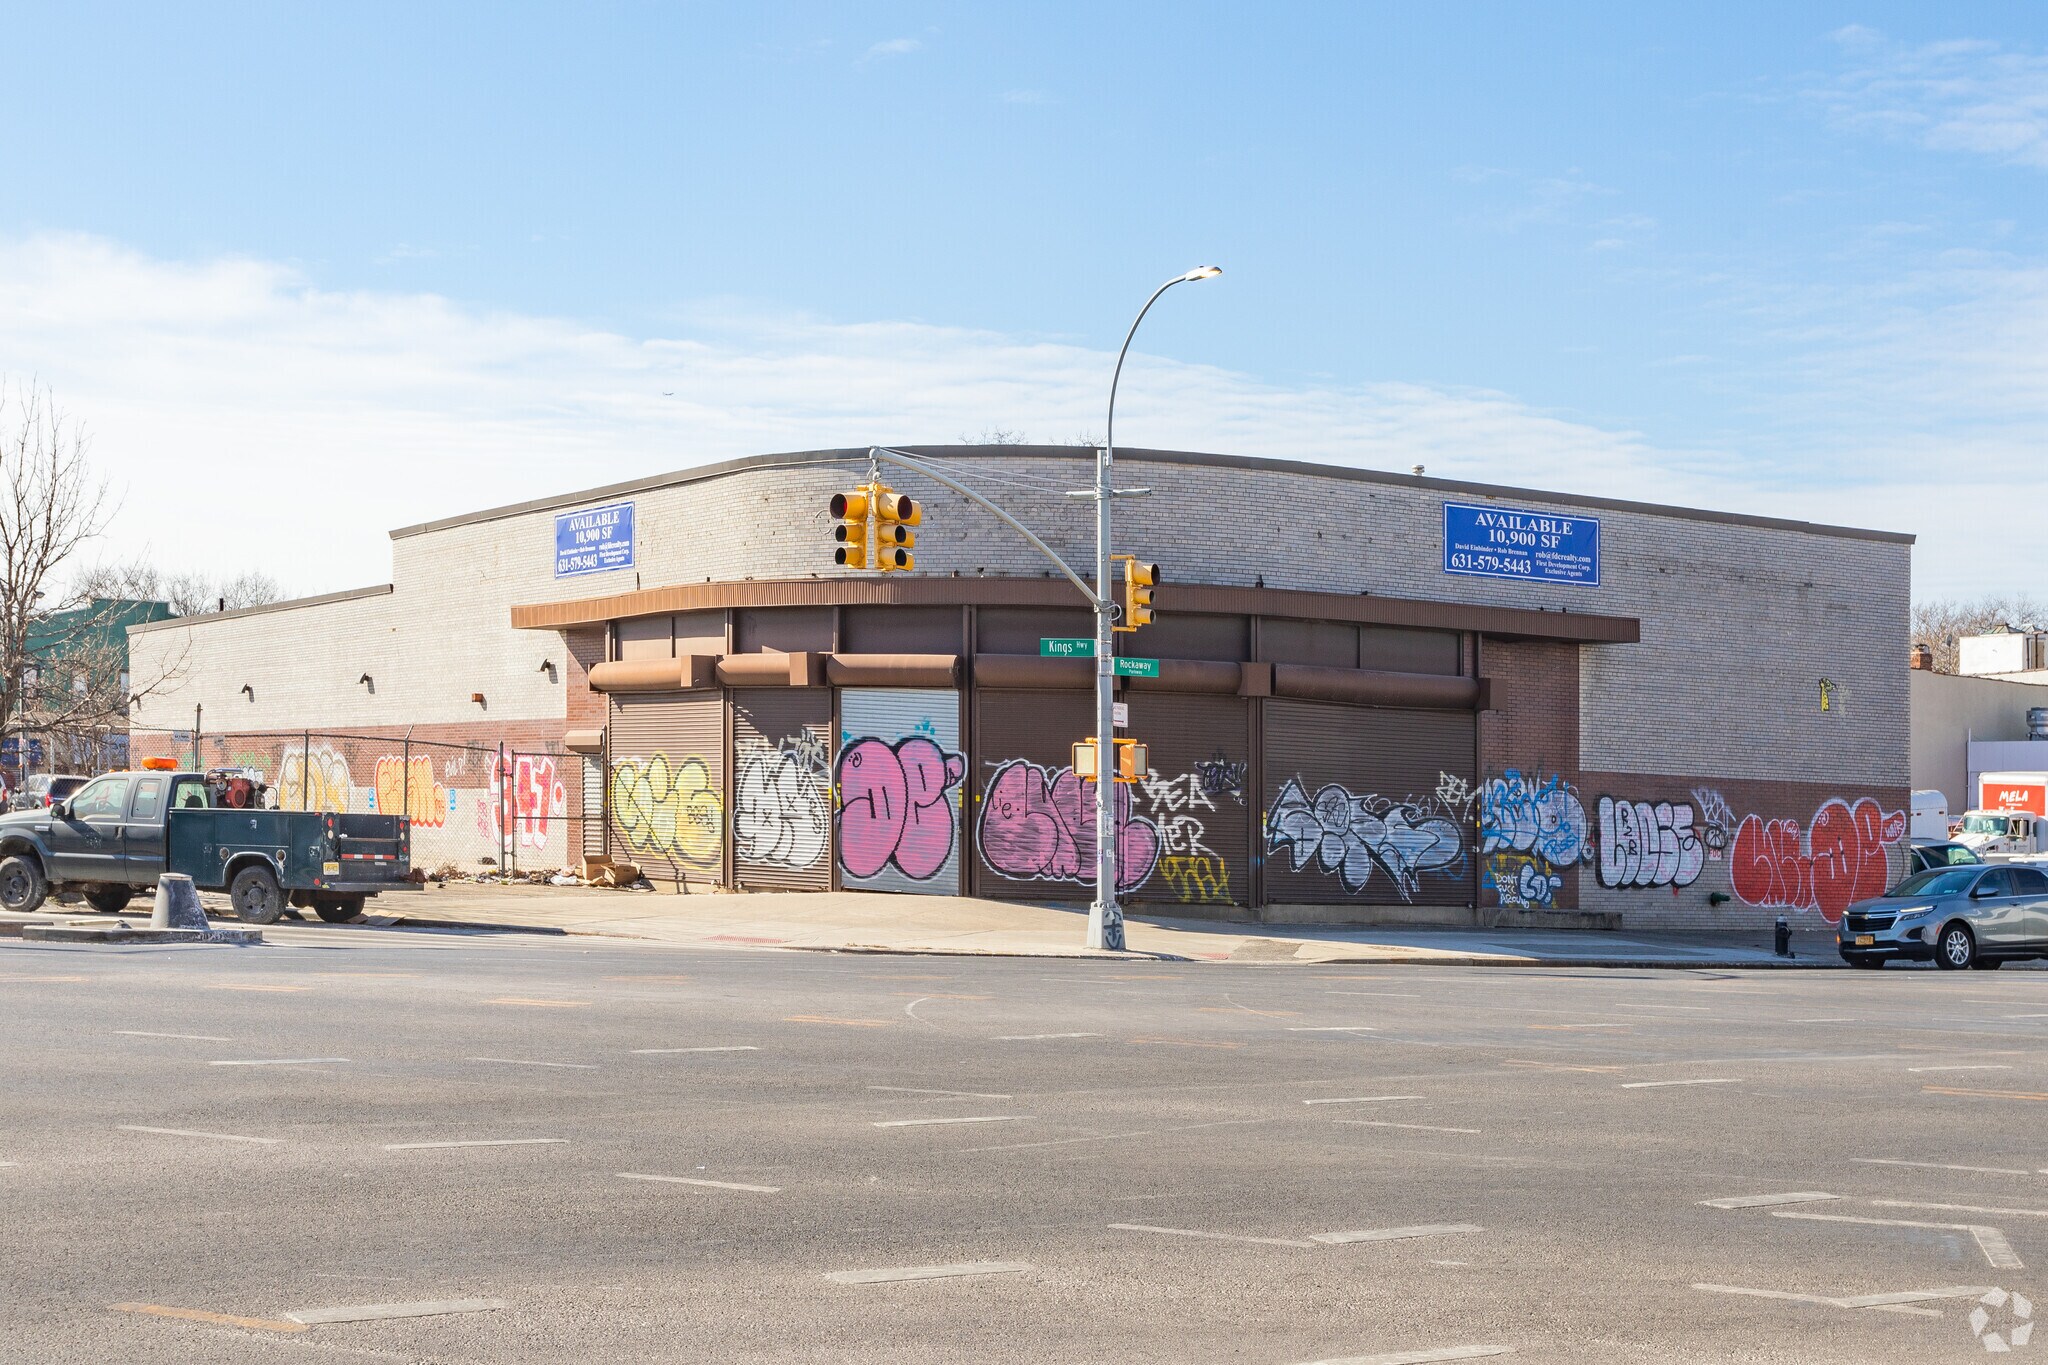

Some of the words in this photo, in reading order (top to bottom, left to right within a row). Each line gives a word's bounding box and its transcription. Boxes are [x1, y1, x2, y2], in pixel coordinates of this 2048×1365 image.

[569, 511, 620, 532] AVAILABLE
[1475, 513, 1572, 535] AVAILABLE
[576, 528, 600, 545] 10,900
[602, 526, 613, 540] SF
[1489, 530, 1536, 546] 10,900
[1541, 535, 1560, 549] SF
[558, 554, 598, 573] 631-579-5443
[1452, 553, 1531, 574] 631-579-5443
[1578, 564, 1592, 572] Corp.
[1567, 570, 1583, 578] Agents
[1049, 641, 1072, 656] Kings
[1076, 641, 1088, 649] Hwy
[1120, 659, 1151, 671] Rockaway
[1999, 790, 2029, 802] MELA
